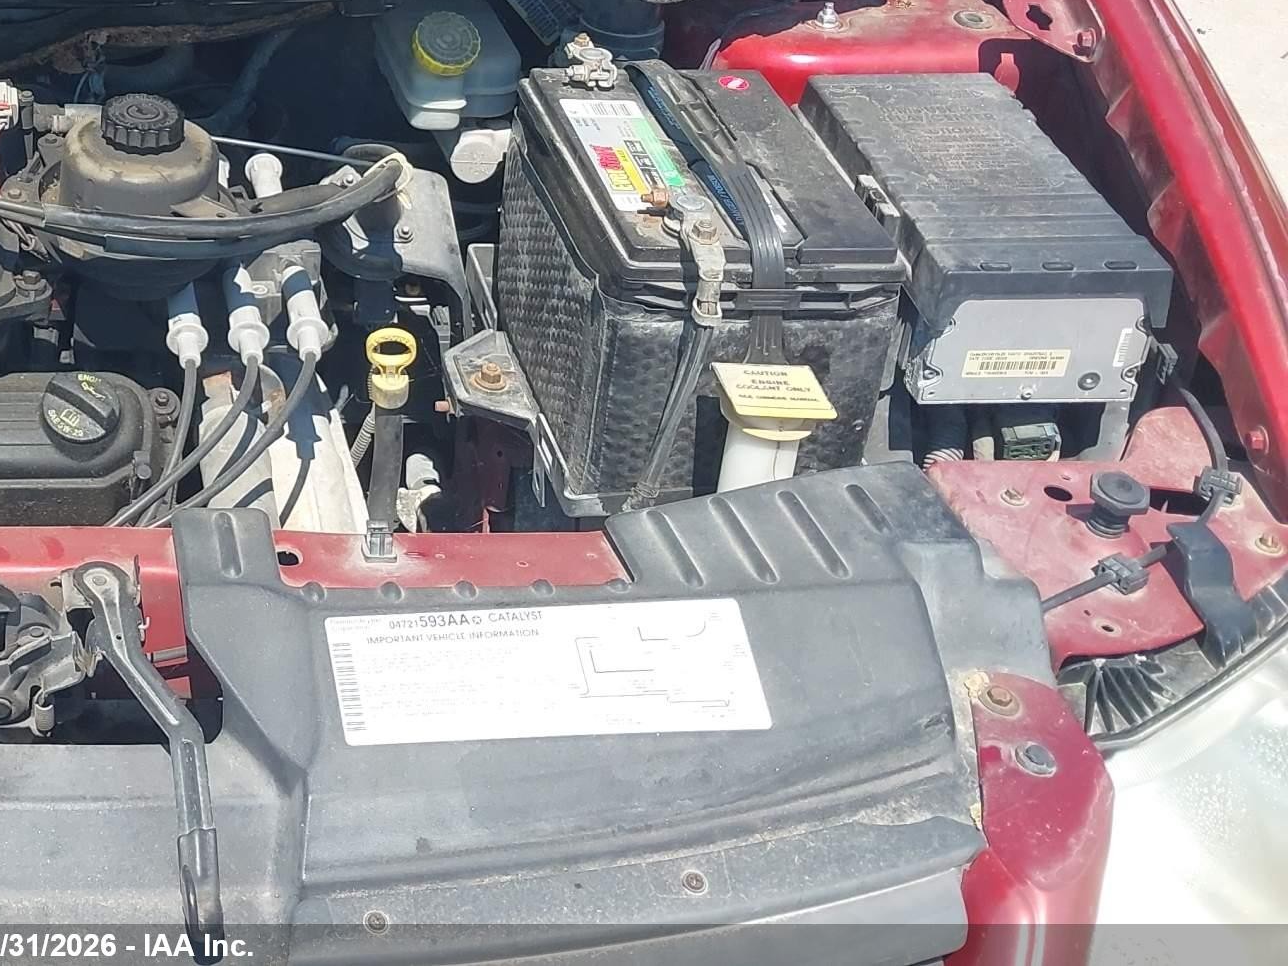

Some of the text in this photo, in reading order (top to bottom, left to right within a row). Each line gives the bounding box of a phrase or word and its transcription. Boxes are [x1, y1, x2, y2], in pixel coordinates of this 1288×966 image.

[743, 369, 789, 377] CAUTION
[488, 610, 544, 623] CATALYST
[366, 628, 540, 645] IMPORTANT VEHICLE INFORMATION
